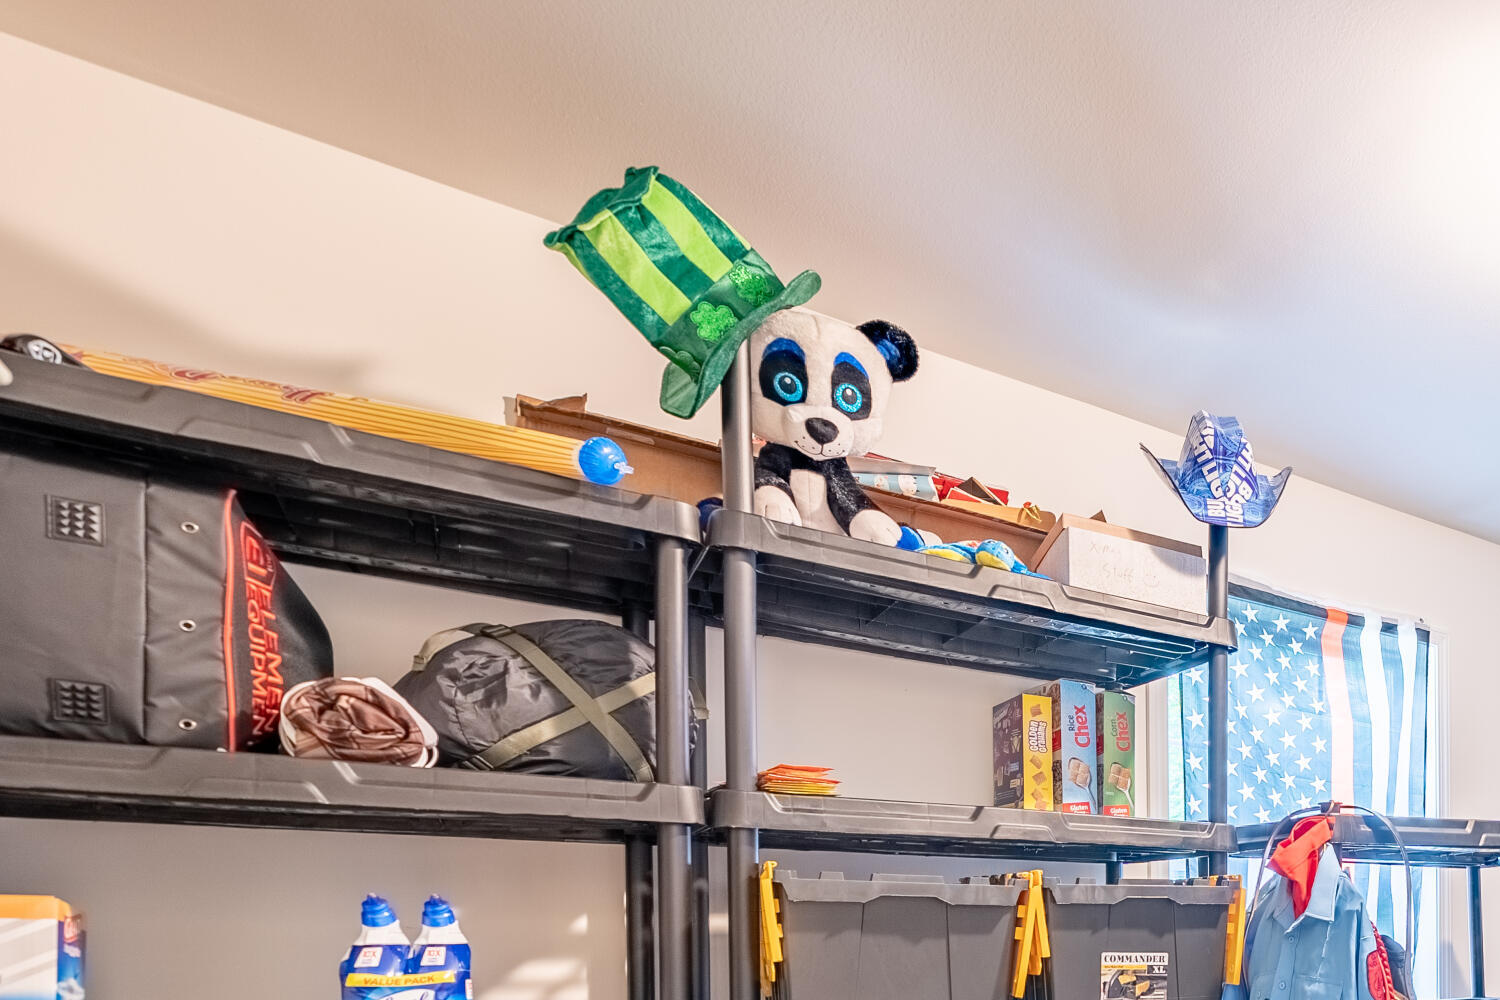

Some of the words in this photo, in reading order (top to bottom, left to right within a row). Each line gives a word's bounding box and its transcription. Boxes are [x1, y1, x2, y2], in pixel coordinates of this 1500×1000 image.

[247, 584, 267, 735] EQUIPMEN
[259, 583, 283, 732] ELEMEN
[1074, 705, 1091, 748] Chex
[1116, 712, 1131, 752] Chex
[1104, 955, 1165, 963] COMMANDER
[1152, 966, 1166, 974] XL
[364, 977, 400, 986] VALUE
[404, 975, 435, 985] PACK
